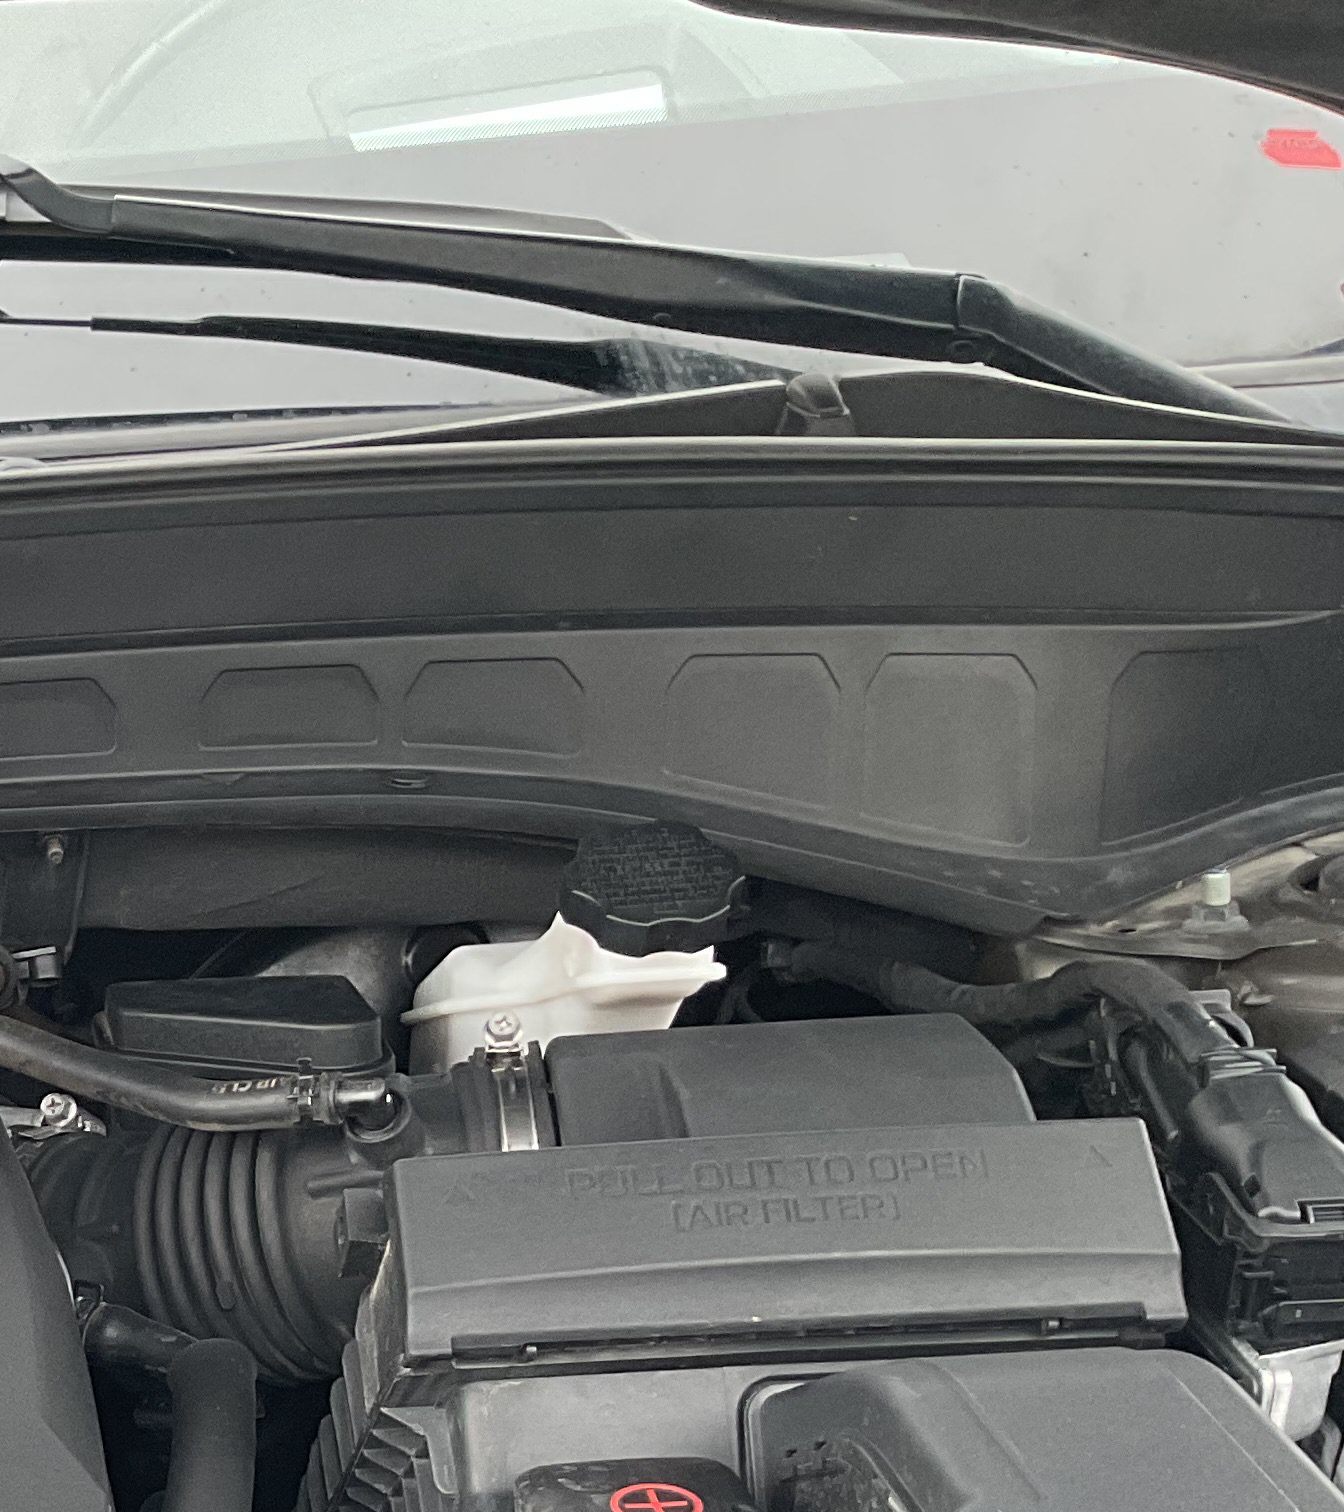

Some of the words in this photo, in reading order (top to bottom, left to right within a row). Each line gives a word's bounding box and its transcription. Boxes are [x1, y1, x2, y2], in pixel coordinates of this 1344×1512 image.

[566, 1164, 683, 1198] PULL
[692, 1158, 785, 1193] OUT
[793, 1154, 855, 1187] TO
[866, 1149, 989, 1183] OPEN
